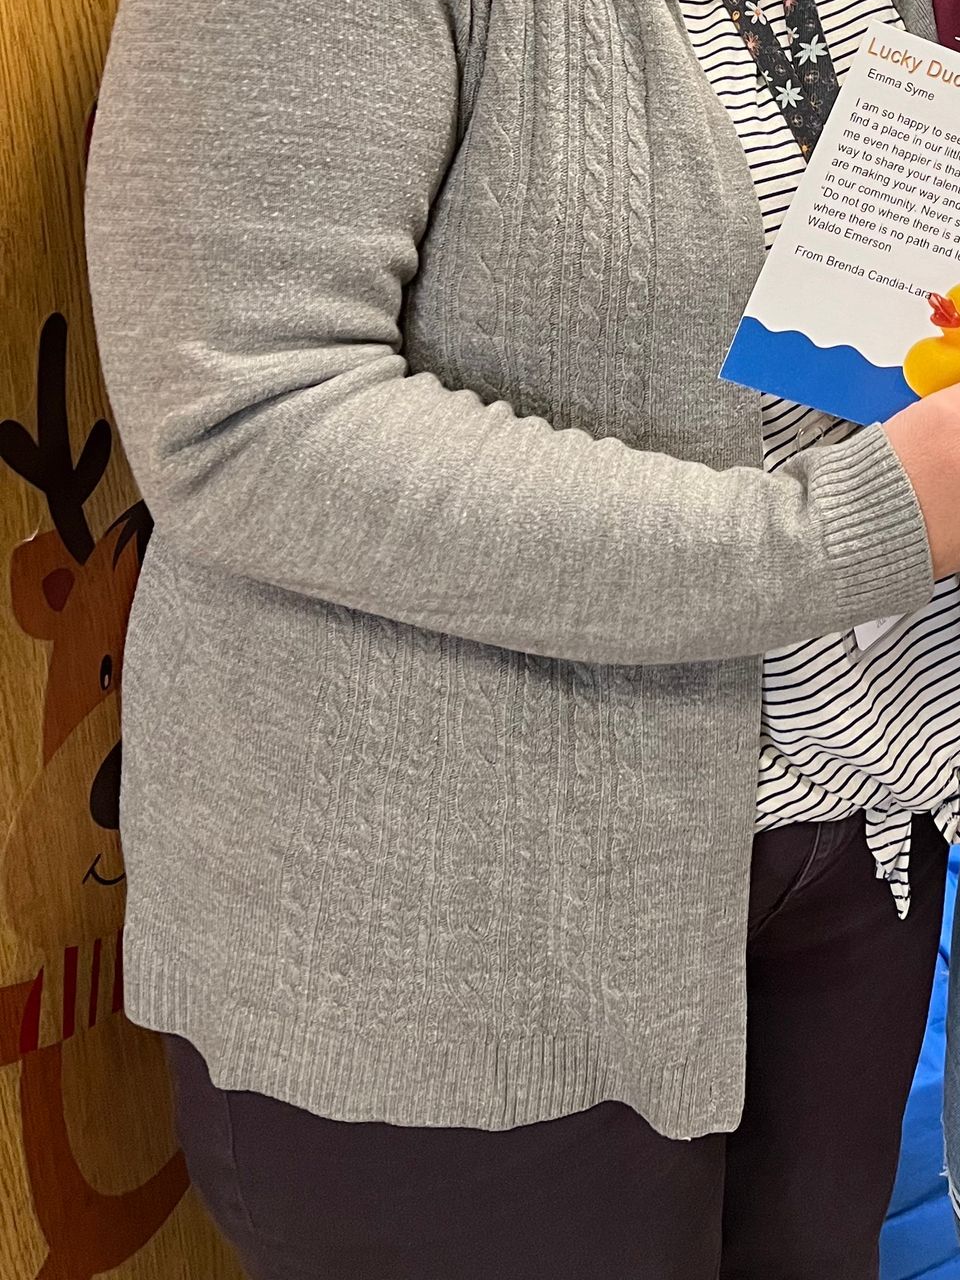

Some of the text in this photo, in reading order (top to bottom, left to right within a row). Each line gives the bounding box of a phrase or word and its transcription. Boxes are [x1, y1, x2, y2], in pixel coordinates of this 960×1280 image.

[867, 37, 923, 74] Lucky
[867, 67, 935, 101] Emma Syme
[849, 111, 871, 127] find
[871, 122, 879, 131] a
[880, 125, 911, 142] place
[912, 134, 923, 146] in
[924, 140, 943, 153] our
[855, 97, 861, 107] I
[861, 101, 879, 114] am
[881, 109, 895, 120] so
[897, 113, 931, 134] happy
[932, 126, 943, 138] to
[838, 143, 860, 159] way
[862, 150, 873, 162] to
[874, 156, 905, 174] share
[906, 168, 932, 183] your
[843, 129, 861, 141] me
[863, 136, 890, 152] even
[891, 144, 932, 167] happier
[932, 159, 943, 171] is
[824, 171, 836, 183] in
[837, 177, 857, 190] our
[857, 184, 917, 213] community.
[920, 204, 954, 224] Never
[831, 158, 850, 170] are
[852, 165, 891, 187] making
[892, 179, 917, 194] your
[919, 188, 941, 204] way
[807, 215, 893, 253] Waldo Emerson
[813, 202, 847, 220] where
[848, 213, 877, 231] there
[878, 223, 888, 235] is
[890, 229, 905, 240] no
[905, 234, 930, 250] path
[932, 244, 954, 258] and
[841, 195, 860, 208] not
[860, 202, 876, 213] go
[878, 206, 911, 226] where
[912, 219, 940, 236] there
[941, 228, 952, 240] is
[953, 235, 960, 244] a
[794, 245, 932, 300] From Brenda Candia-Lara
